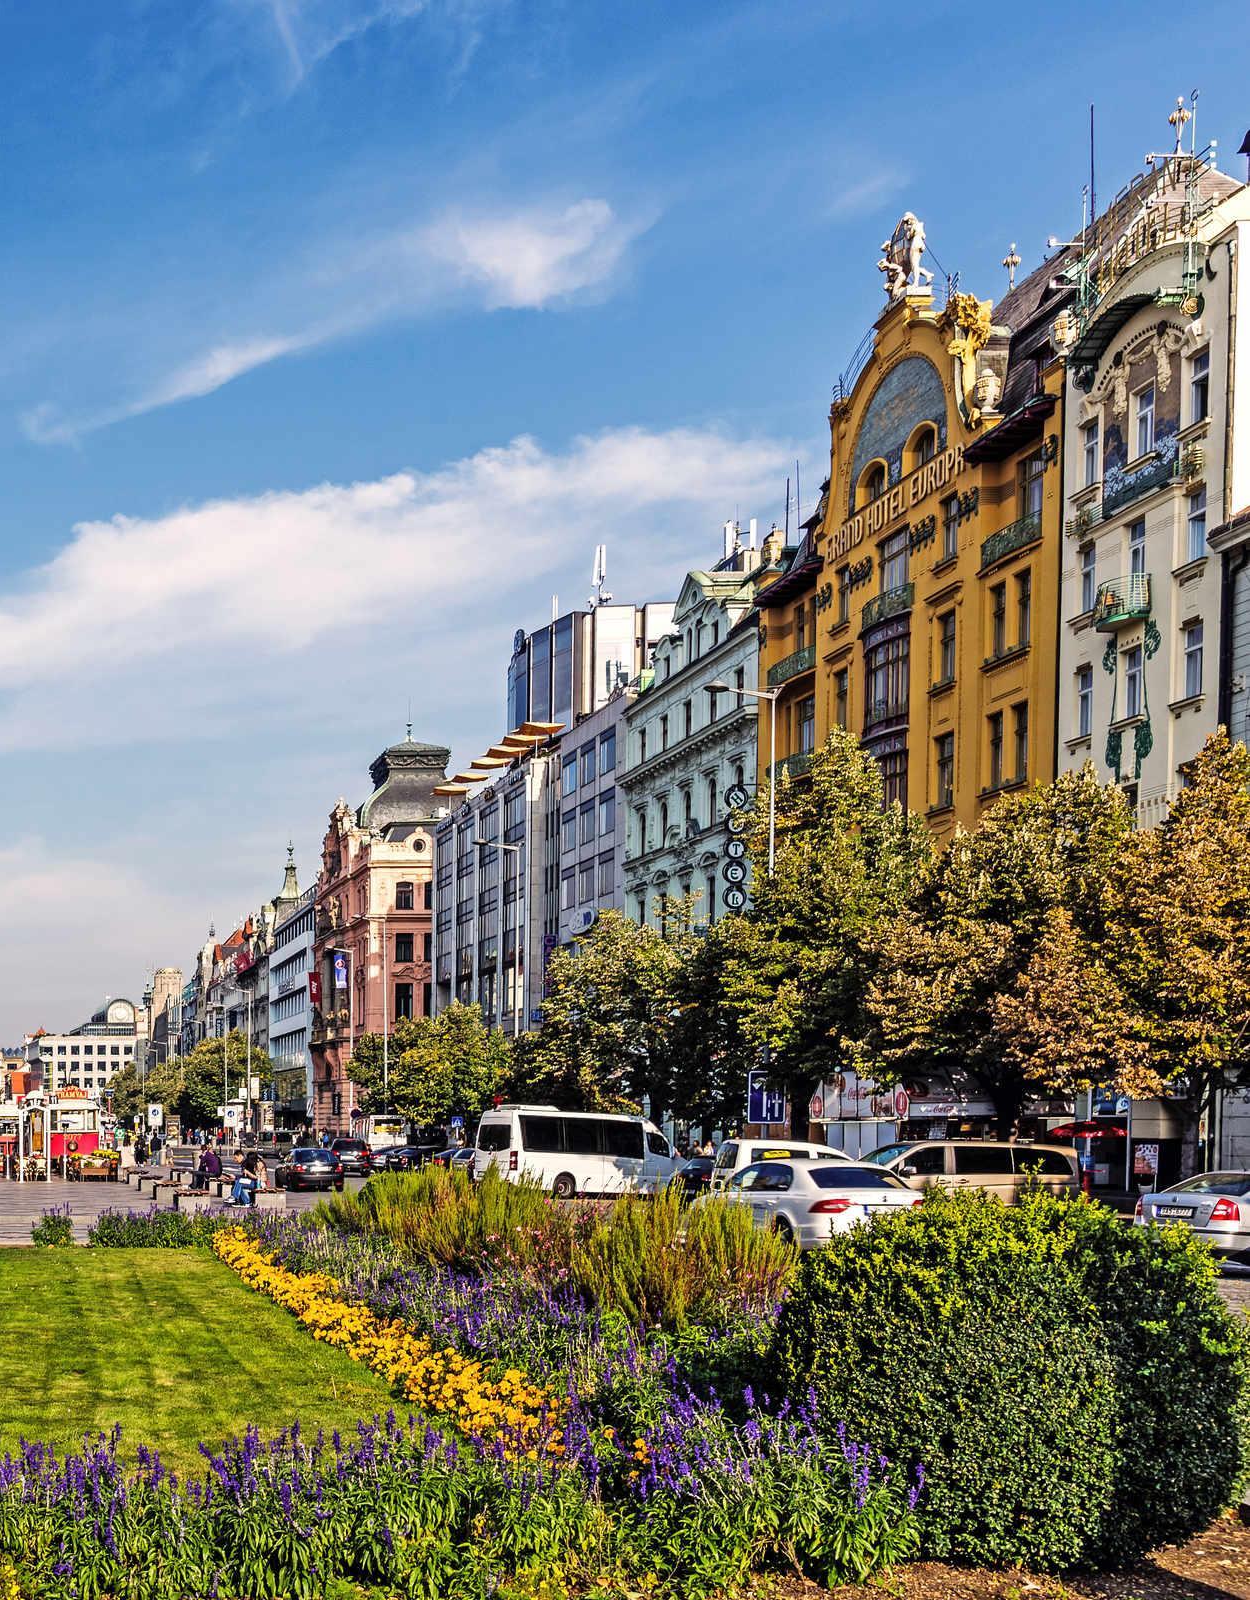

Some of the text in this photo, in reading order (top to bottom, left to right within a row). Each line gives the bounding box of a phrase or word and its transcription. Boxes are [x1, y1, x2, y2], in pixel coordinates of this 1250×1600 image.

[826, 441, 967, 564] GRAND HOTEL EUROPA
